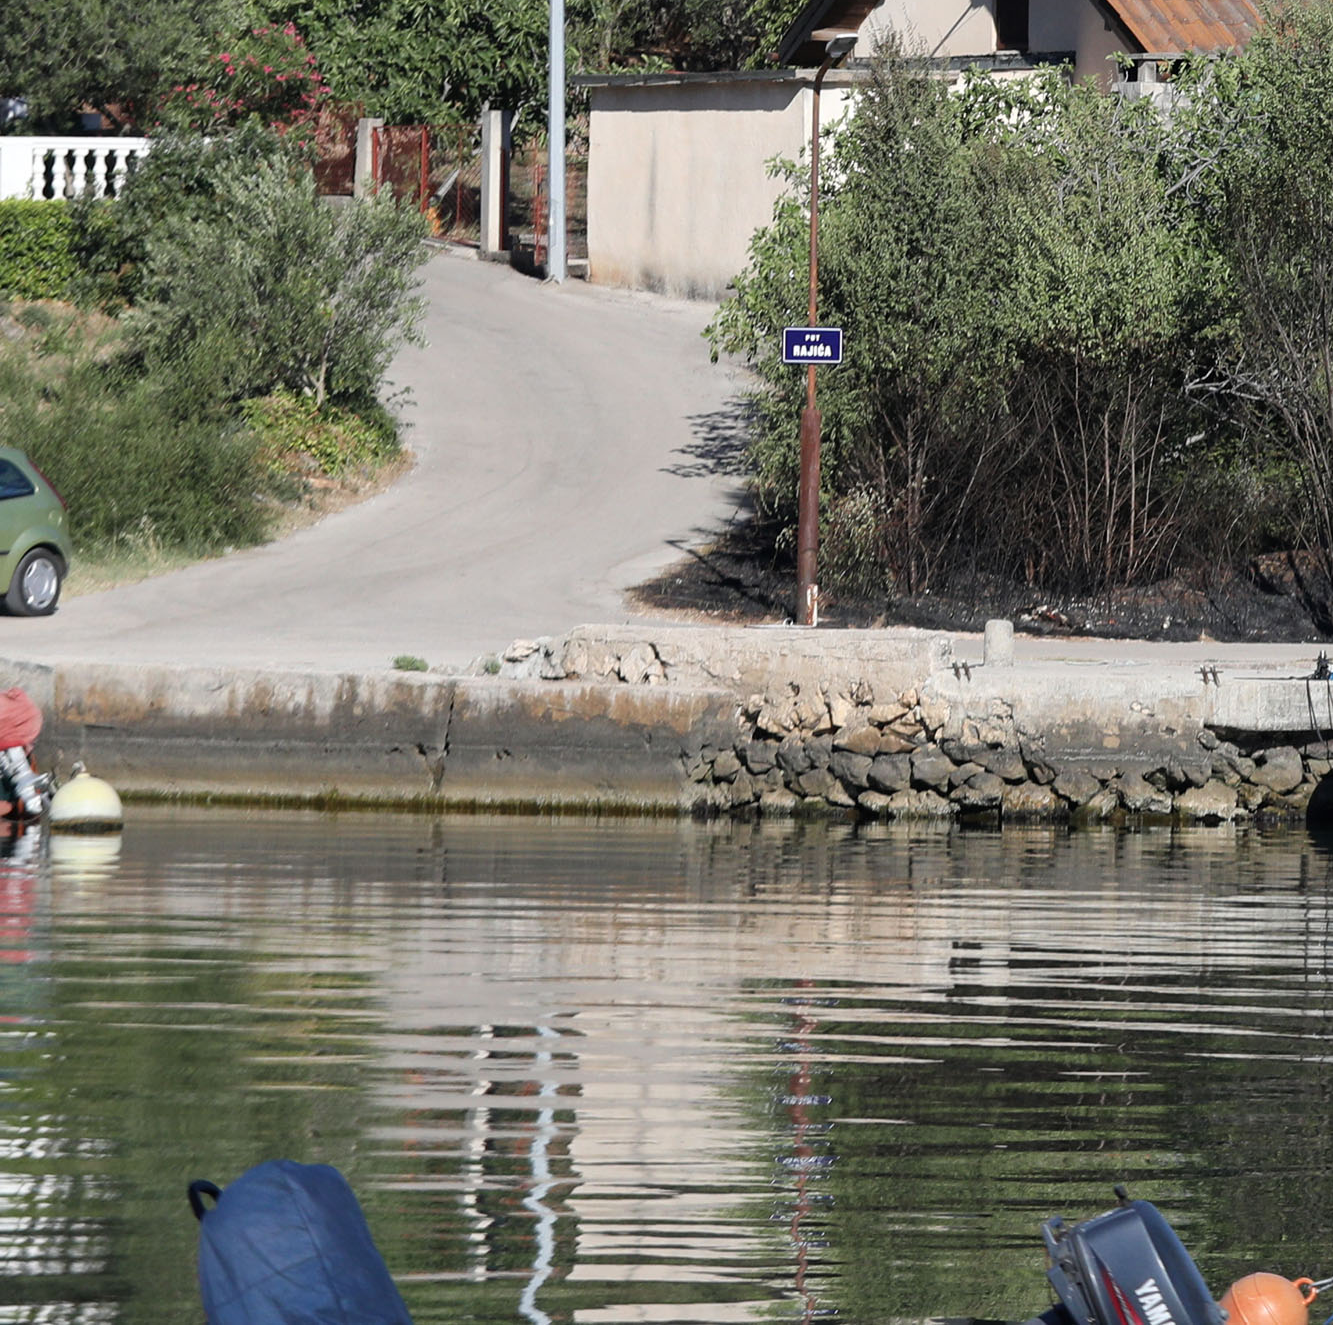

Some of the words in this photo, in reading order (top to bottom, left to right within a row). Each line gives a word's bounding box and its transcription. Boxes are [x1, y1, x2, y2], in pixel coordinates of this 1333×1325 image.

[804, 333, 821, 342] PUT
[792, 343, 832, 357] RAJIĆA
[1134, 1277, 1177, 1325] YAM
